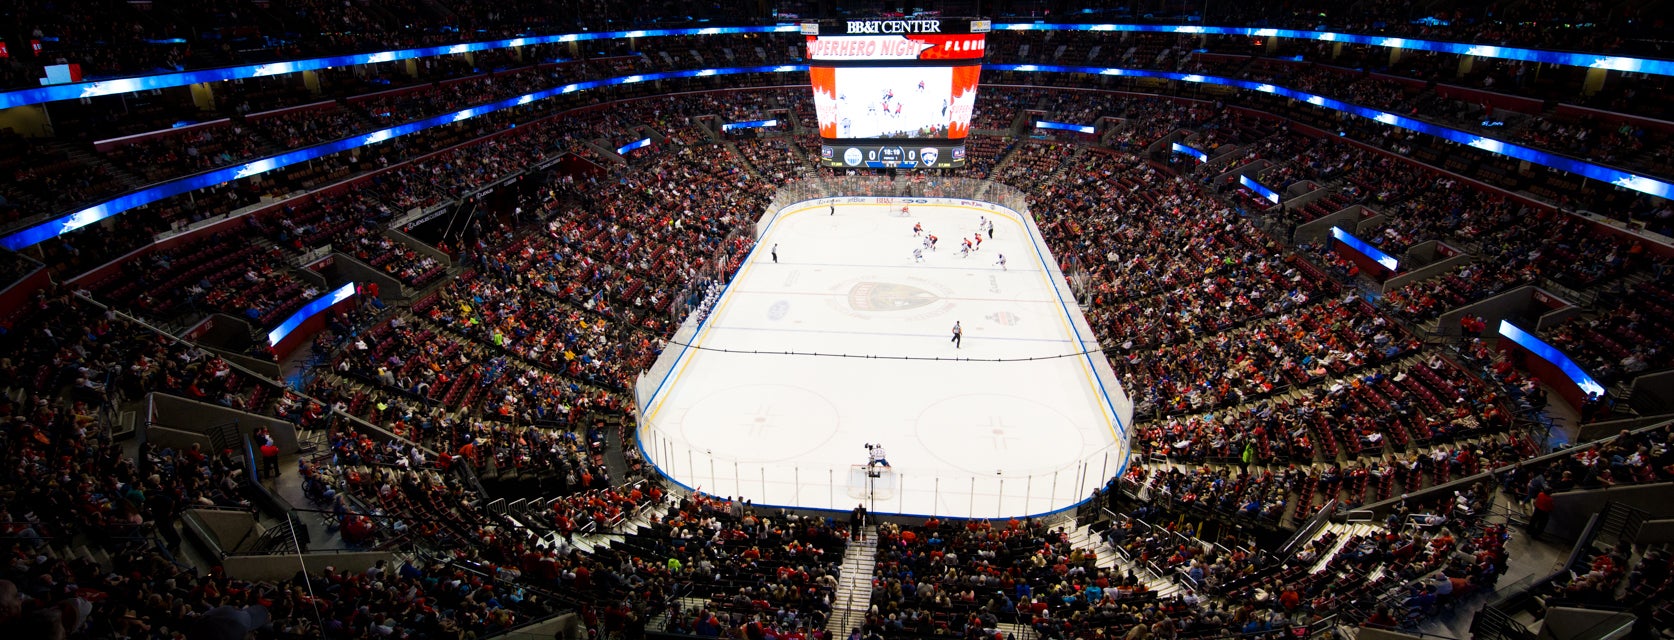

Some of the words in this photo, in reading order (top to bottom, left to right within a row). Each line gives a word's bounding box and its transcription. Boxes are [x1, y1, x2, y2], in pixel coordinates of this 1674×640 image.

[846, 20, 881, 34] BB&T
[881, 20, 941, 33] CENTER
[880, 39, 925, 56] NIGHT
[868, 150, 876, 160] 0
[908, 150, 916, 160] 0
